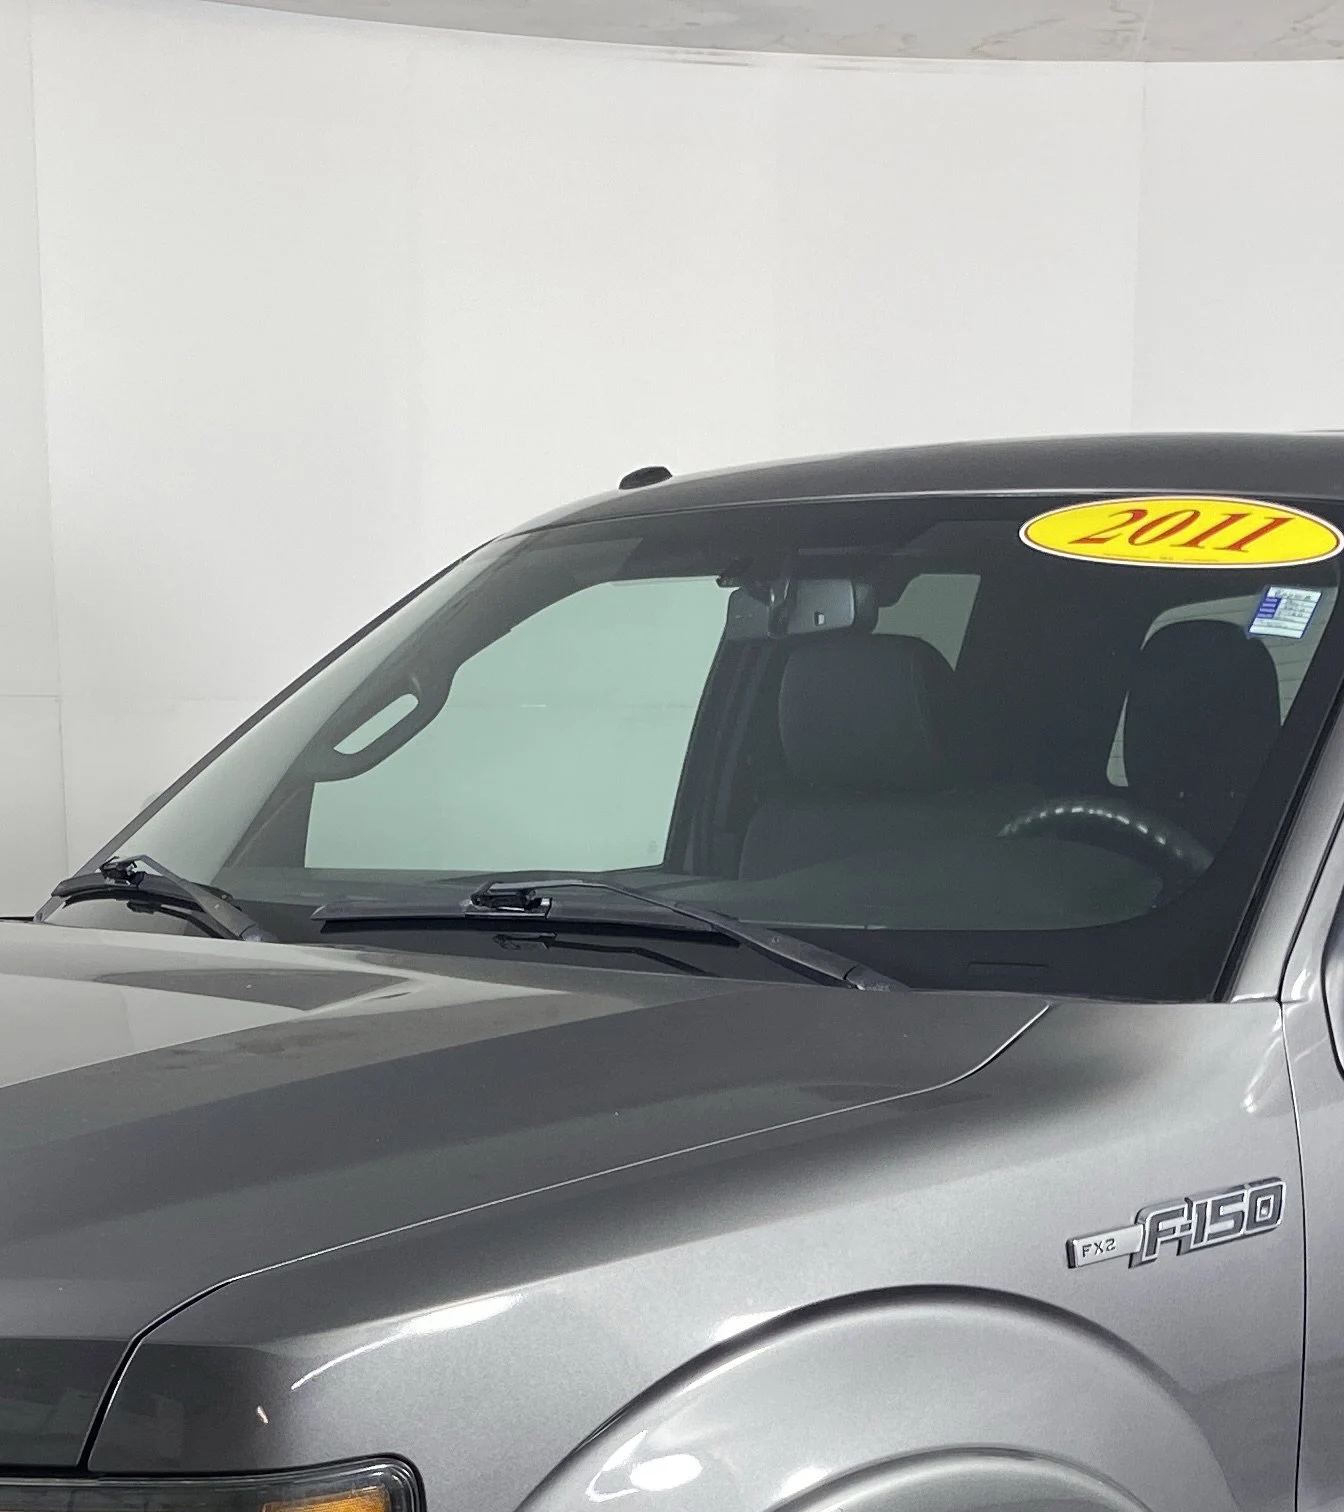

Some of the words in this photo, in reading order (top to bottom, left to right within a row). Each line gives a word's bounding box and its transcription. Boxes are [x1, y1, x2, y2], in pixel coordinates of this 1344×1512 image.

[1067, 508, 1296, 554] 2011
[1081, 1237, 1117, 1259] FX2
[1130, 1177, 1287, 1268] F-150
